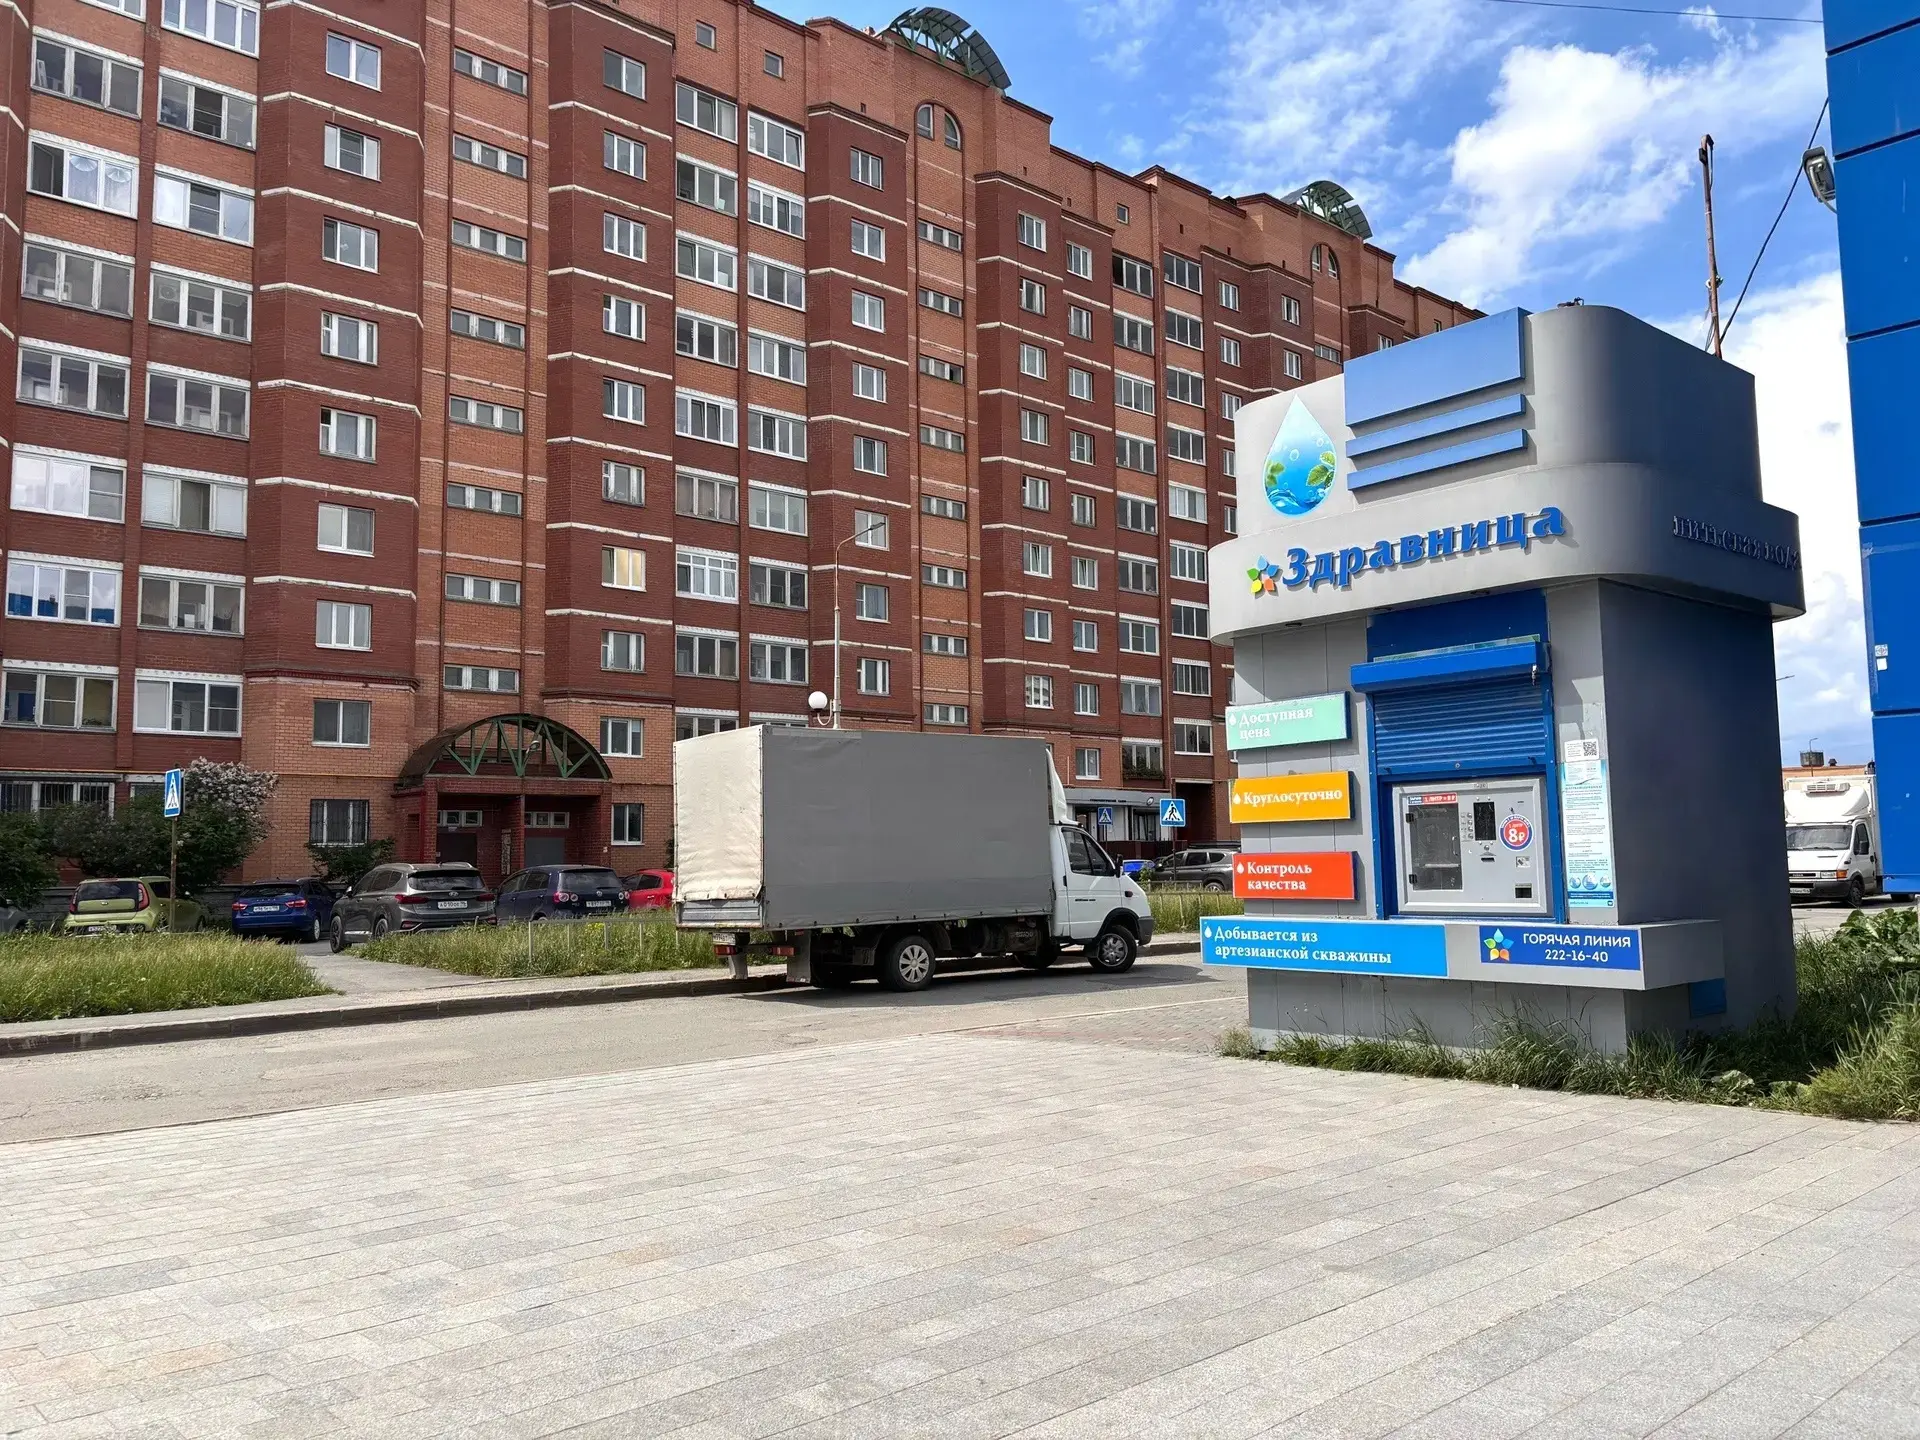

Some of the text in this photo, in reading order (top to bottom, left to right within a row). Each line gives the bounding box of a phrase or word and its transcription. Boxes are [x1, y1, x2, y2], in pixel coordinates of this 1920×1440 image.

[1282, 506, 1566, 589] Здравница
[1239, 706, 1314, 726] Доступная
[1239, 727, 1271, 741] цена
[1243, 789, 1343, 807] Круглосуточно
[1247, 861, 1312, 876] Контроль
[1247, 878, 1307, 891] качества
[1214, 926, 1318, 943] Добывается из
[1523, 933, 1631, 948] ГОРЯЧАЯ ЛИНИЯ
[1214, 943, 1392, 964] артезианской скважины
[1545, 949, 1609, 963] 222-16-40
